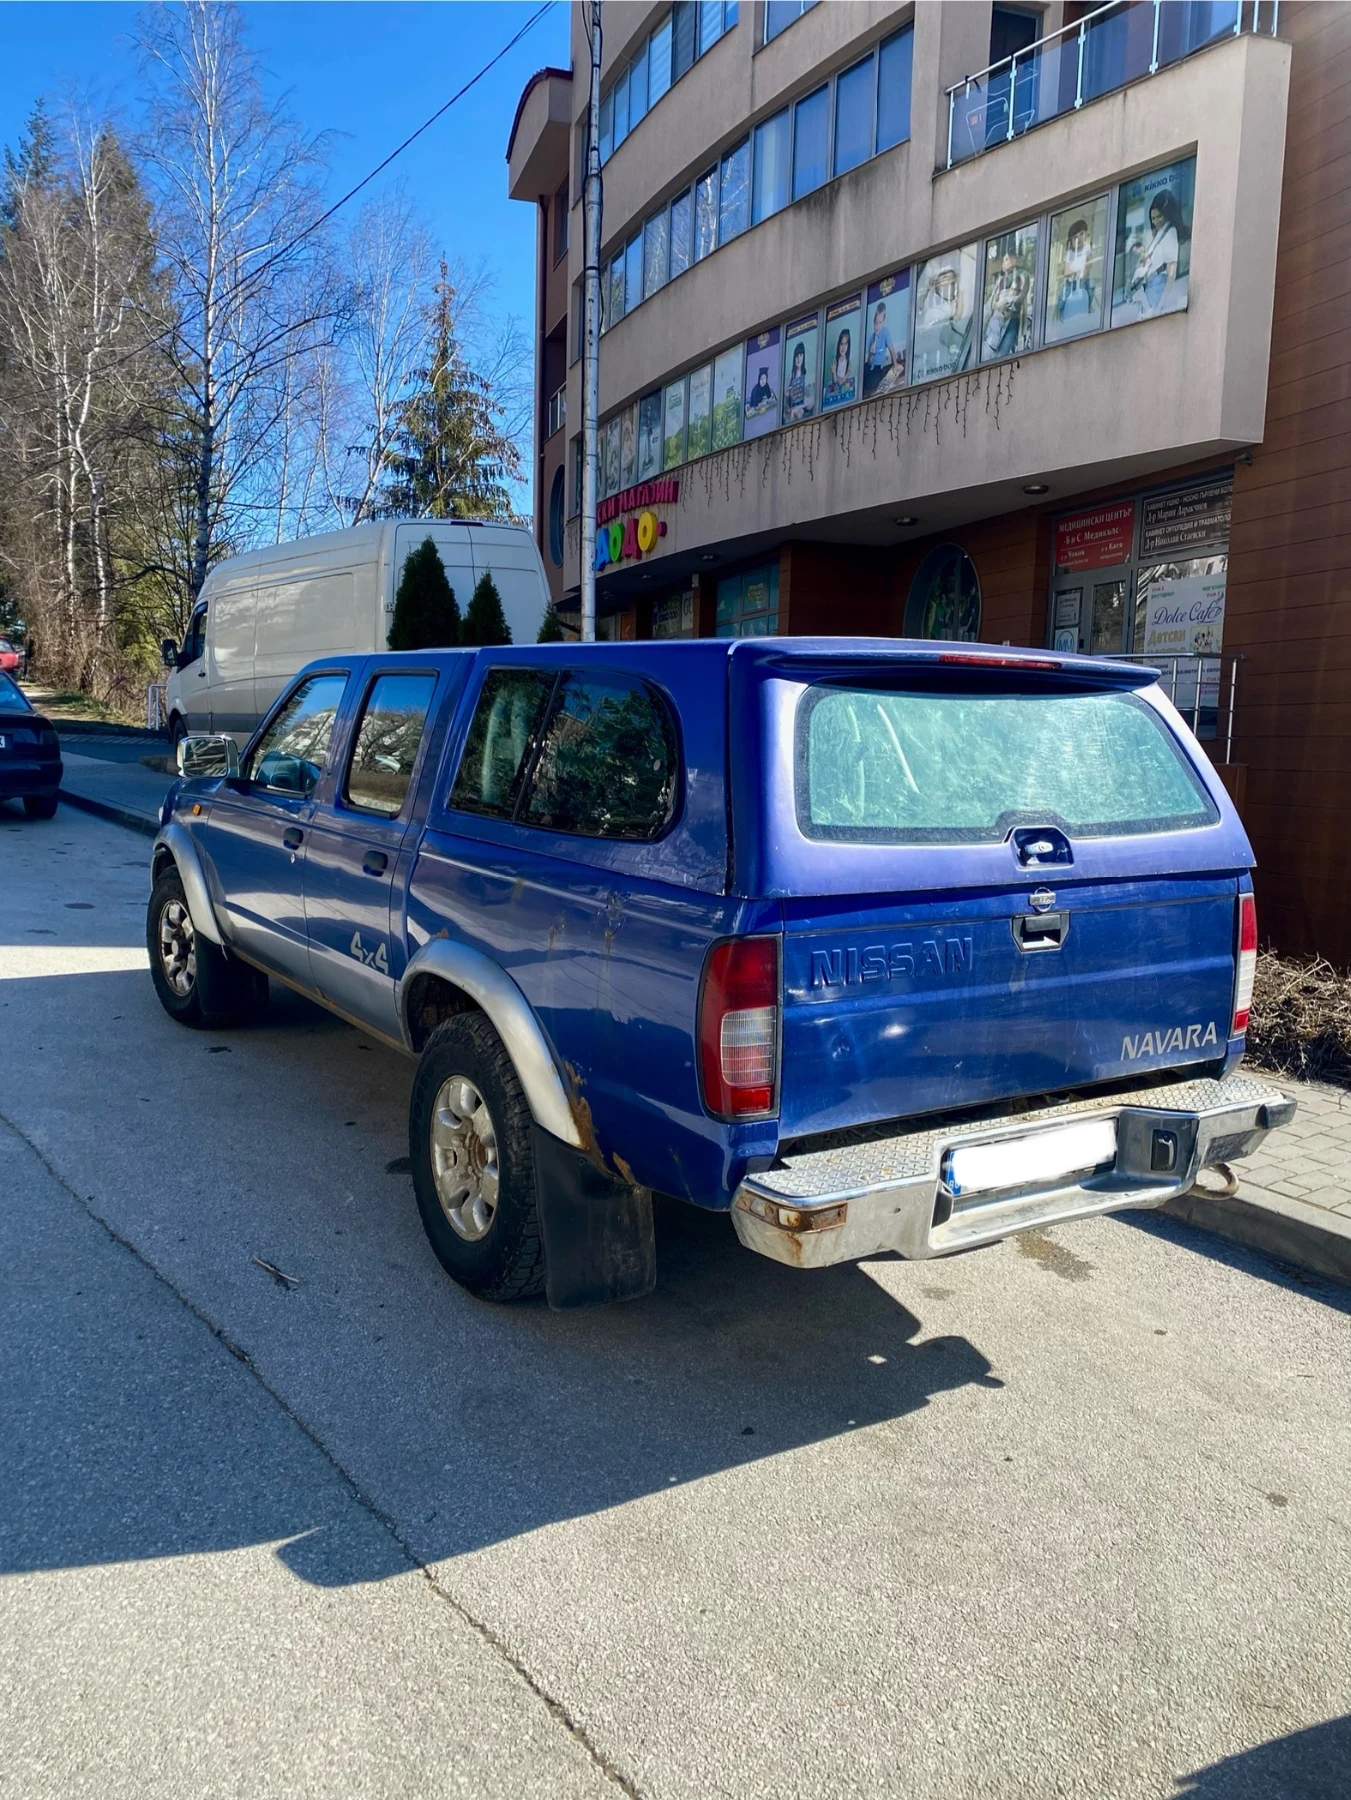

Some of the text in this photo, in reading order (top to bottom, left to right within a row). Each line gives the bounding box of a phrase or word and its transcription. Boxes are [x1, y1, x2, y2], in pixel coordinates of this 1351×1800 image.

[619, 480, 679, 513] МАГАЗИН
[1059, 507, 1132, 532] МЕДИЦИНСКИ ЦЕНТЪР
[1152, 606, 1187, 626] Dolce
[811, 937, 972, 990] NISSAN
[1120, 1021, 1217, 1061] NAVARA
